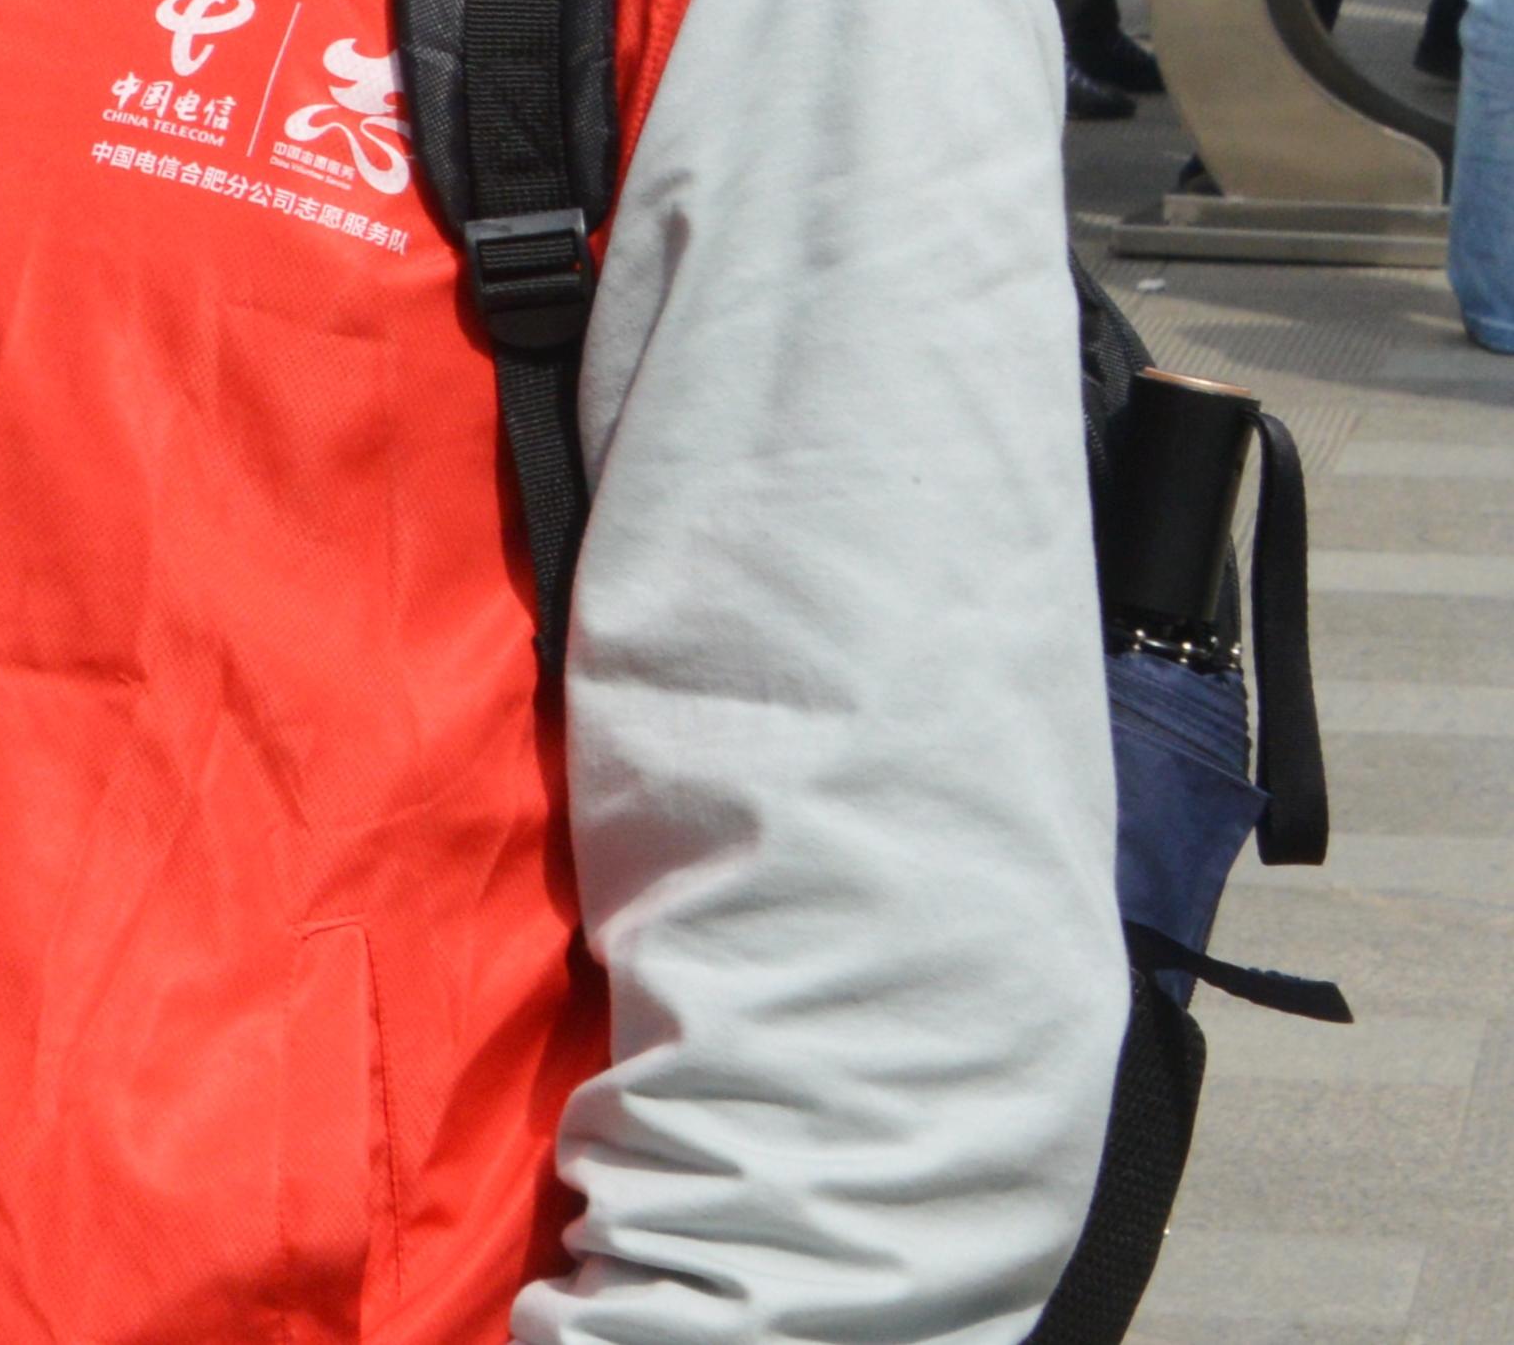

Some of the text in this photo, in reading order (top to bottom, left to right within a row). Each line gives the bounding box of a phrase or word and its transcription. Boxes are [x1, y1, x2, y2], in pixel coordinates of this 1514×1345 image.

[102, 108, 225, 147] CHINA TELECOM
[111, 72, 237, 131] 中国电信
[91, 140, 411, 256] 中国电信合肥分公司志愿服务队
